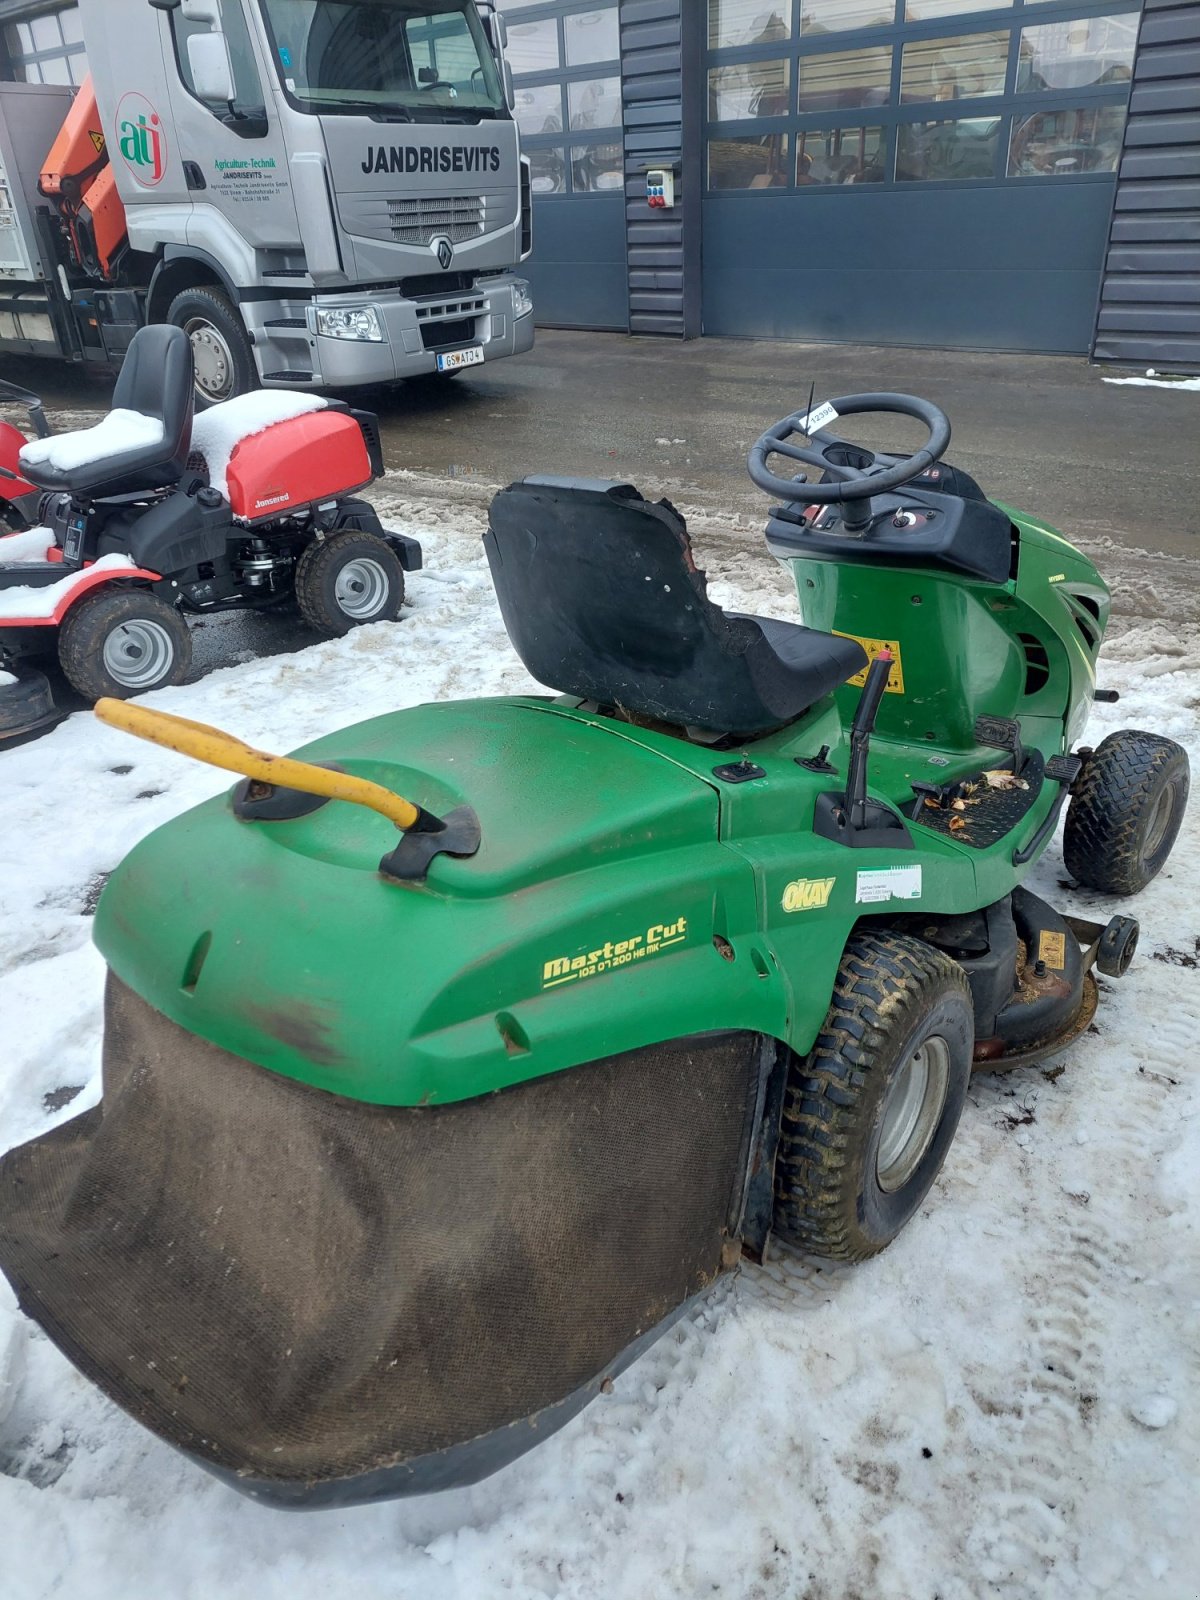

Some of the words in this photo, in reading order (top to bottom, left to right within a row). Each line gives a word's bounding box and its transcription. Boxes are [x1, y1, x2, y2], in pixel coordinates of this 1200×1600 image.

[214, 158, 276, 171] Agriculture-Technik
[361, 146, 500, 174] JANDRISEVITS
[222, 171, 262, 179] JANDRISEVITS
[810, 406, 834, 424] 12390
[254, 492, 290, 509] Jonsered
[782, 877, 836, 912] OKAY
[543, 936, 643, 980] Master
[646, 916, 687, 944] Cut
[578, 965, 596, 978] 102
[613, 952, 632, 967] 200
[633, 948, 646, 960] HE
[646, 942, 660, 955] MK
